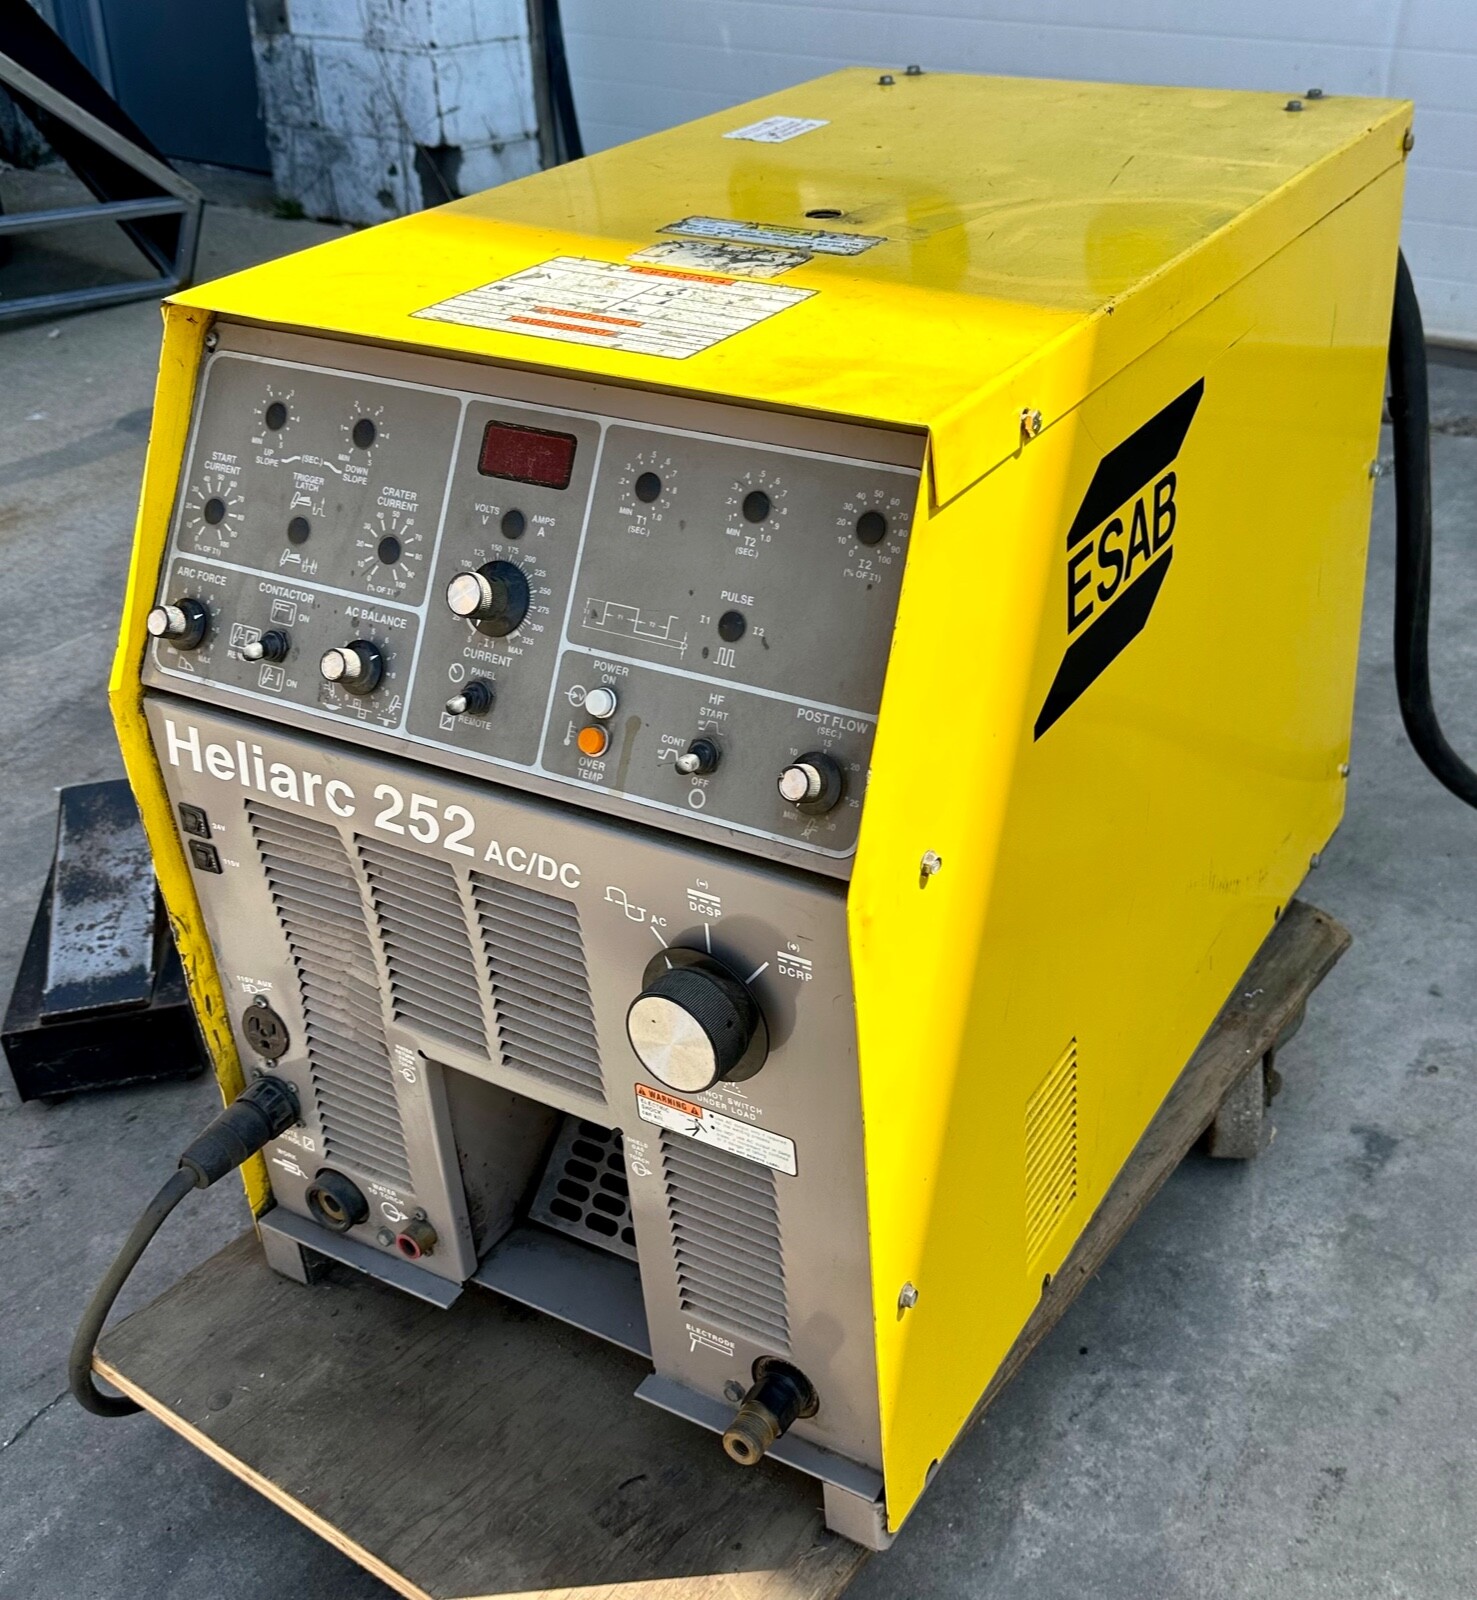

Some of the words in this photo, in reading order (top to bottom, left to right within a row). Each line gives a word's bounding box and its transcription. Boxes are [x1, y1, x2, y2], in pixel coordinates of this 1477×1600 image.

[212, 451, 238, 464] START
[263, 448, 274, 456] UP
[255, 456, 279, 467] SLOPE
[204, 460, 242, 475] CURRENT
[345, 464, 369, 476] DOWN
[293, 471, 325, 486] TRIGGER
[342, 473, 368, 486] SLOPE
[295, 481, 320, 492] LATCH
[382, 486, 418, 501] CRATER
[856, 492, 866, 500] 40
[874, 490, 884, 498] 50
[376, 496, 419, 512] CURRENT
[843, 502, 853, 511] 30
[890, 498, 900, 506] 60
[392, 510, 400, 518] 50
[474, 502, 500, 515] VOLTS
[376, 511, 385, 519] 40
[482, 515, 489, 525] V
[531, 514, 556, 527] AMPS
[636, 514, 647, 525] T1
[899, 512, 908, 520] 70
[836, 517, 846, 526] 20
[537, 527, 545, 537] A
[898, 529, 908, 537] 80
[415, 534, 423, 542] 70
[744, 536, 756, 547] T2
[837, 536, 847, 544] 10
[473, 548, 485, 557] 125
[491, 543, 502, 552] 150
[507, 546, 519, 554] 175
[890, 546, 900, 554] 90
[524, 554, 536, 563] 200
[1067, 471, 1177, 636] ESAB
[460, 559, 472, 568] 100
[859, 559, 872, 570] I2
[878, 556, 891, 564] 100
[177, 566, 196, 579] ARC
[196, 570, 228, 586] FORCE
[534, 569, 546, 577] 225
[855, 570, 868, 579] OF
[258, 582, 315, 604] CONTACTOR
[539, 587, 552, 595] 250
[720, 590, 755, 607] PULSE
[537, 606, 550, 615] 275
[298, 613, 310, 623] ON
[345, 605, 360, 618] AC
[361, 609, 408, 629] BALANCE
[700, 614, 710, 624] I1
[531, 623, 544, 632] 300
[752, 626, 765, 637] I2
[522, 636, 534, 645] 325
[507, 645, 524, 656] MAX
[463, 647, 513, 667] CURRENT
[470, 666, 496, 681] PANEL
[593, 660, 630, 677] POWER
[286, 679, 298, 689] ON
[601, 674, 617, 686] ON
[709, 692, 725, 706] HF
[699, 706, 729, 721] START
[457, 716, 492, 731] REMOTE
[796, 707, 830, 725] POST
[831, 716, 868, 735] FLOW
[661, 734, 686, 748] CONT
[823, 739, 832, 748] 15
[789, 747, 798, 756] 10
[578, 757, 606, 771] OVER
[850, 763, 860, 772] 20
[577, 768, 604, 783] TEMP
[691, 776, 710, 788] OFF
[165, 719, 356, 818] Heliarc
[373, 784, 476, 858] 252
[483, 840, 582, 889] AC/DC
[849, 799, 860, 808] 25
[689, 901, 722, 918] DCSP
[650, 914, 667, 927] AC
[778, 964, 813, 981] DCRP
[648, 1090, 687, 1110] WARNING
[705, 1090, 723, 1101] NOT
[727, 1097, 763, 1115] SWITCH
[696, 1094, 728, 1110] UNDER
[731, 1106, 756, 1120] LOAD
[371, 1182, 397, 1197] WATER
[685, 1322, 736, 1350] ELECTRODE
